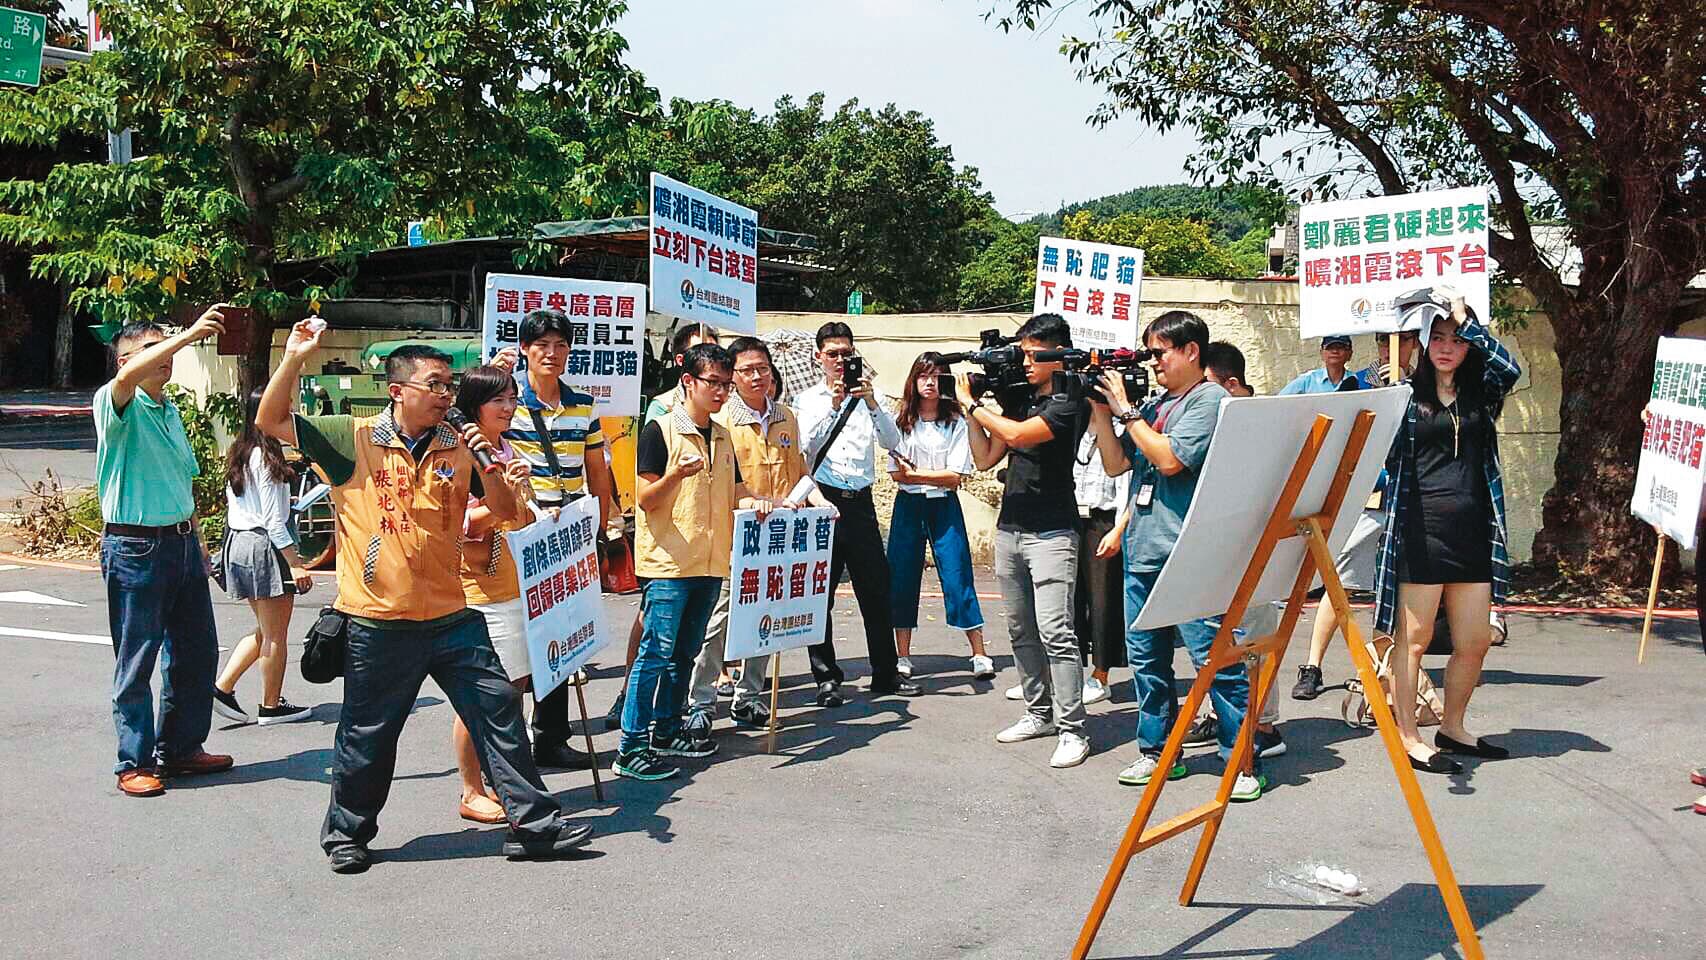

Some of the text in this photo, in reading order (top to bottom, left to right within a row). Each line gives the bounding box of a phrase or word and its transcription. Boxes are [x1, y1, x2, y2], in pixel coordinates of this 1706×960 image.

[0, 39, 14, 49] d.
[13, 16, 31, 36] 路
[1303, 203, 1487, 250] 鄭麗君硬起來
[653, 225, 756, 285] 立刻下台滾蛋
[1042, 245, 1136, 285] 無恥肥貓
[1305, 243, 1487, 288] 曠湘霞滾下台
[497, 289, 635, 319] 譴責央廣高層
[1040, 280, 1131, 321] 下台滾蛋
[496, 319, 634, 346] 迫層員工
[742, 516, 831, 557] 政黨輪替
[525, 551, 599, 621] 回歸專業任用
[739, 560, 828, 605] 無恥留任
